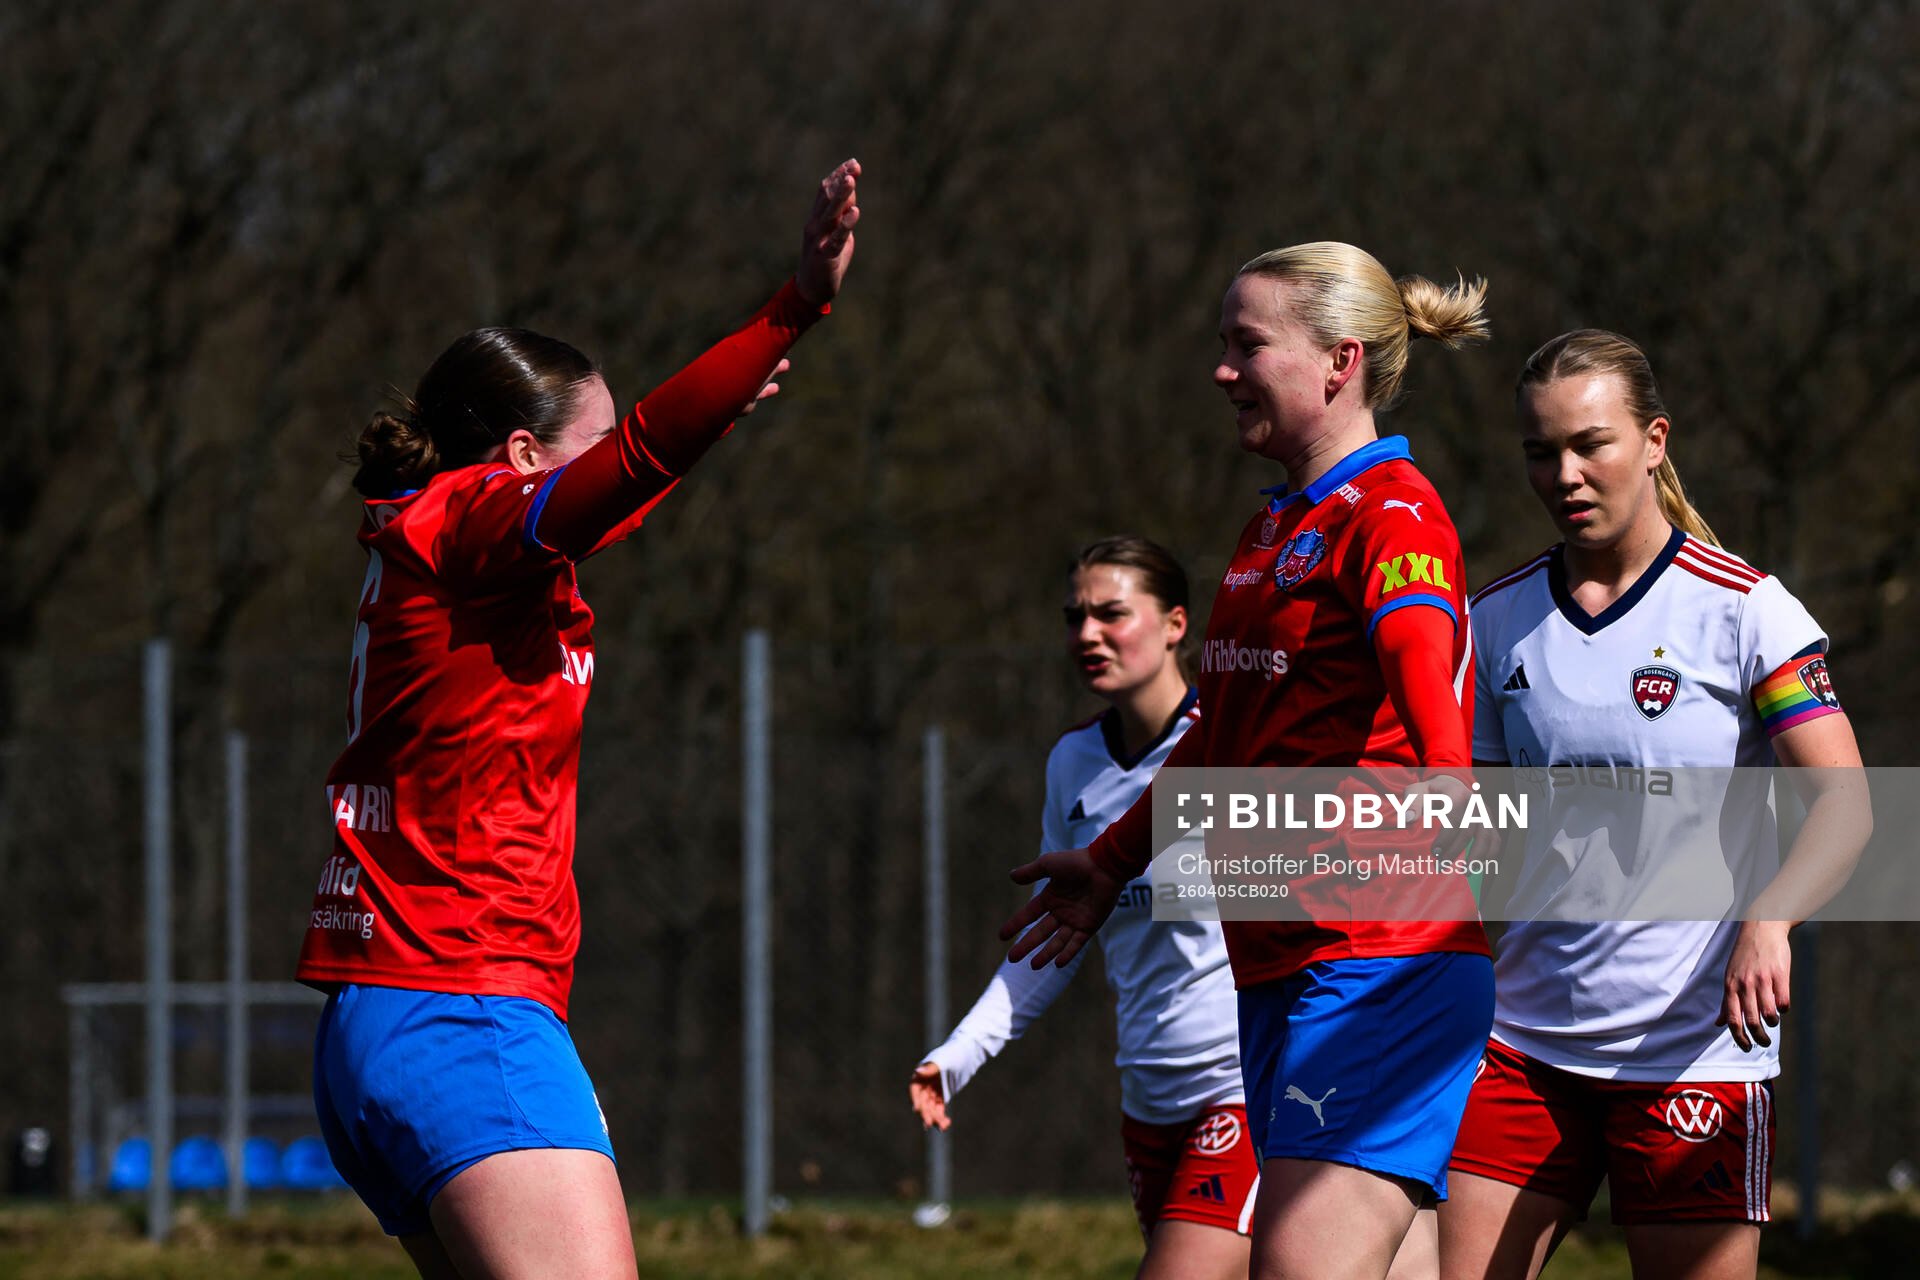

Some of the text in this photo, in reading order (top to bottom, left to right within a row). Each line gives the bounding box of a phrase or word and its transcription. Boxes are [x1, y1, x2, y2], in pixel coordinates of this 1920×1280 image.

[1377, 552, 1452, 594] XXL
[1201, 638, 1289, 680] Wihborgs
[1636, 679, 1673, 695] FCR
[1810, 671, 1831, 689] FC
[326, 783, 391, 832] ARD
[317, 856, 362, 895] olid
[310, 904, 375, 939] rsäkring
